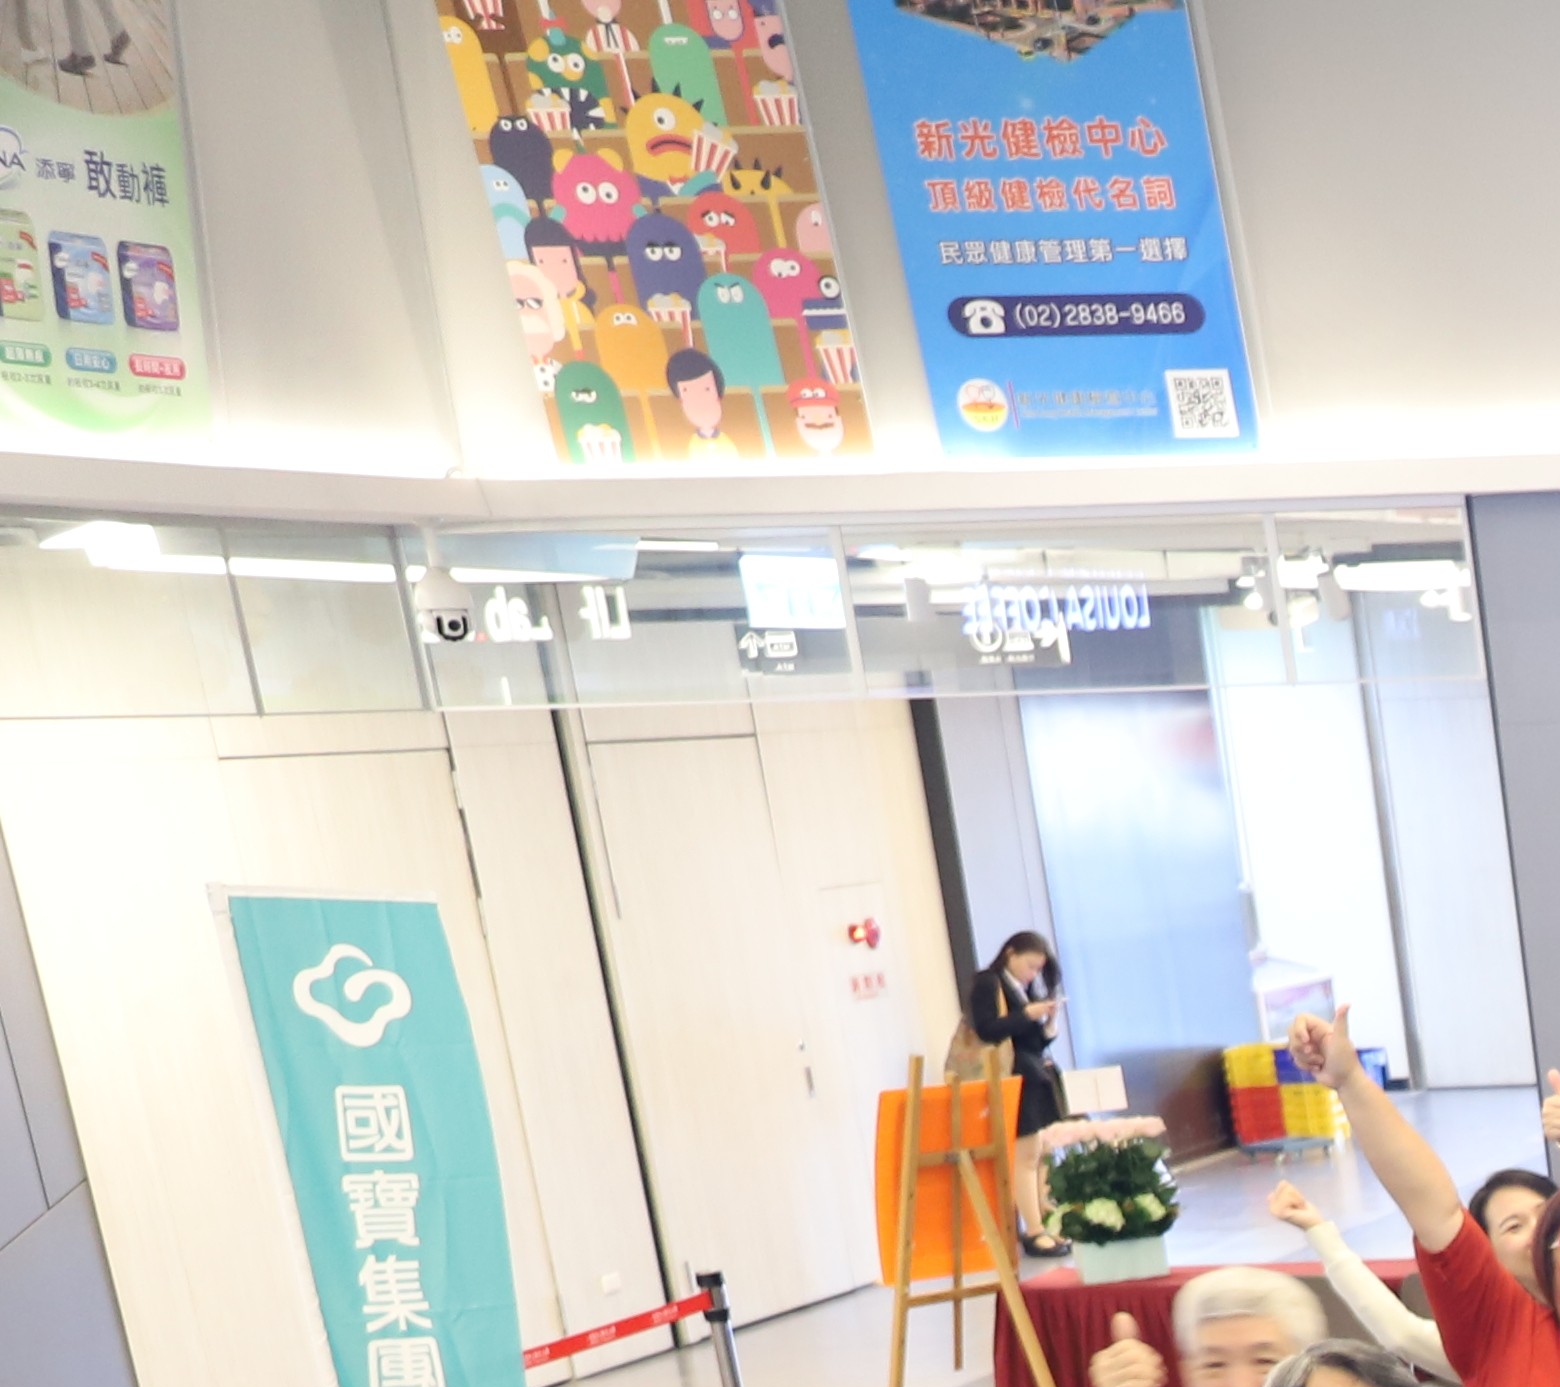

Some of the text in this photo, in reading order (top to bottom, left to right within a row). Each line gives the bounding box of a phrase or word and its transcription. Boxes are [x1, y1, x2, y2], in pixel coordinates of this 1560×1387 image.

[914, 117, 1167, 160] 新光健檢中心
[926, 177, 1177, 212] 頂級健檢代名詞
[939, 236, 1188, 265] 民眾健康管理第一選擇
[1014, 301, 1187, 328] (02)2838-9466
